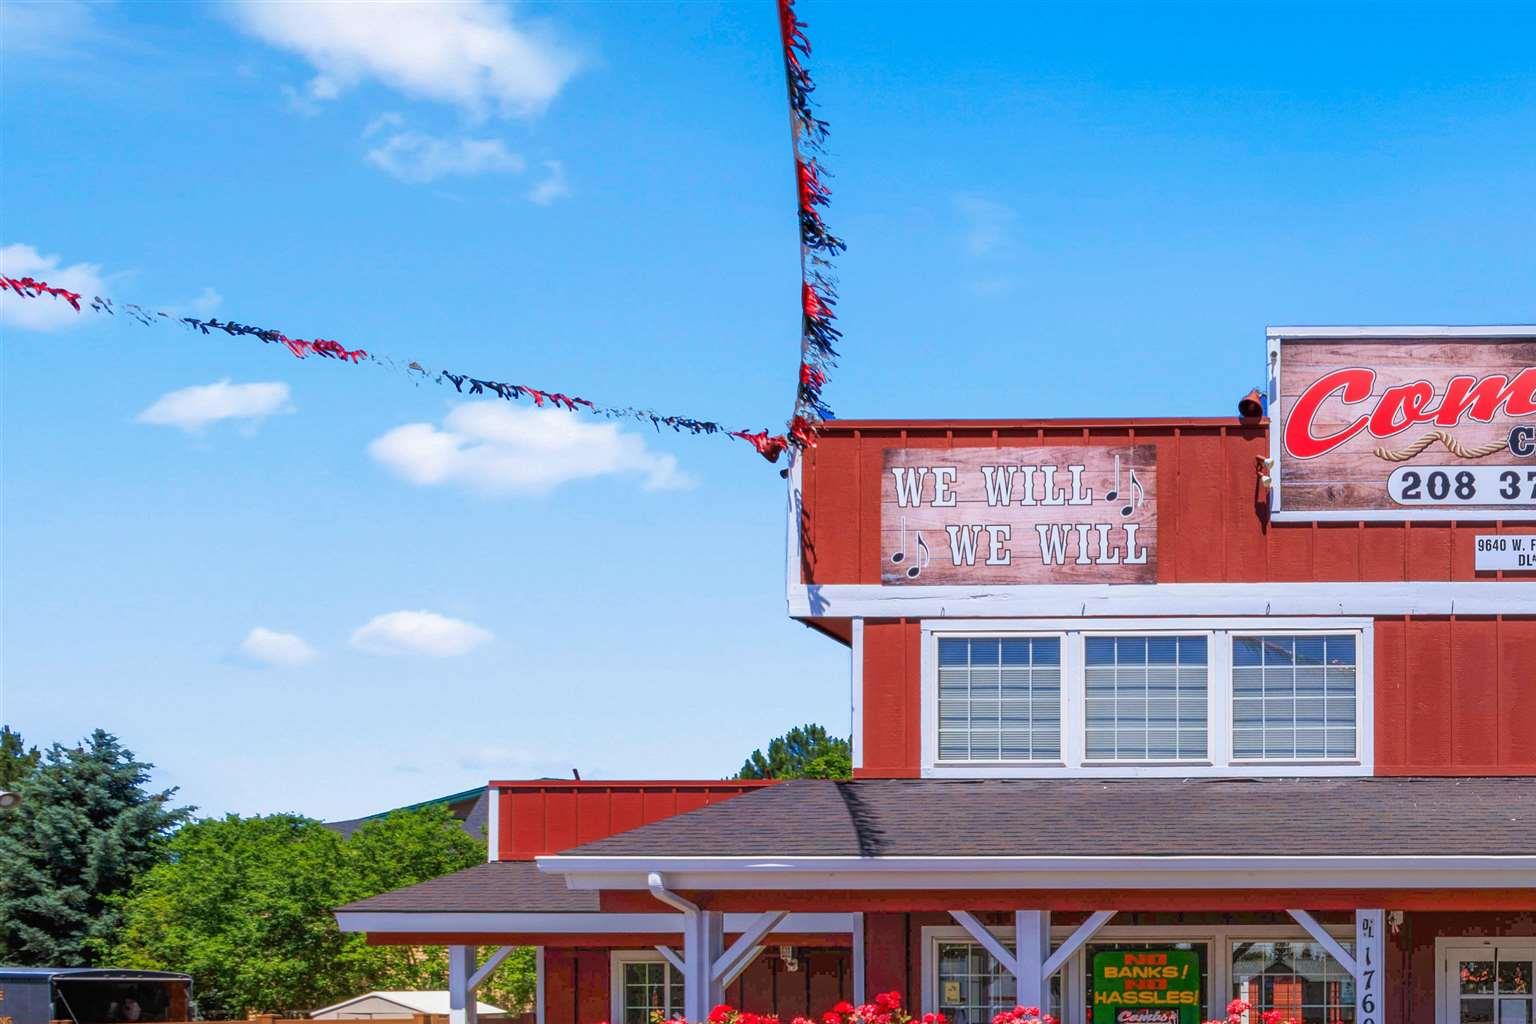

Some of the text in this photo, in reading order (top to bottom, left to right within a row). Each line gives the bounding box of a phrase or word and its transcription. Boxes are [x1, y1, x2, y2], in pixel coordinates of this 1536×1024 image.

[892, 465, 1093, 507] WE WILL
[1401, 471, 1477, 500] 208
[945, 523, 1147, 566] WE WILL
[1478, 539, 1506, 551] 9640
[1512, 539, 1526, 551] W.
[1094, 989, 1199, 1005] HASSLES!
